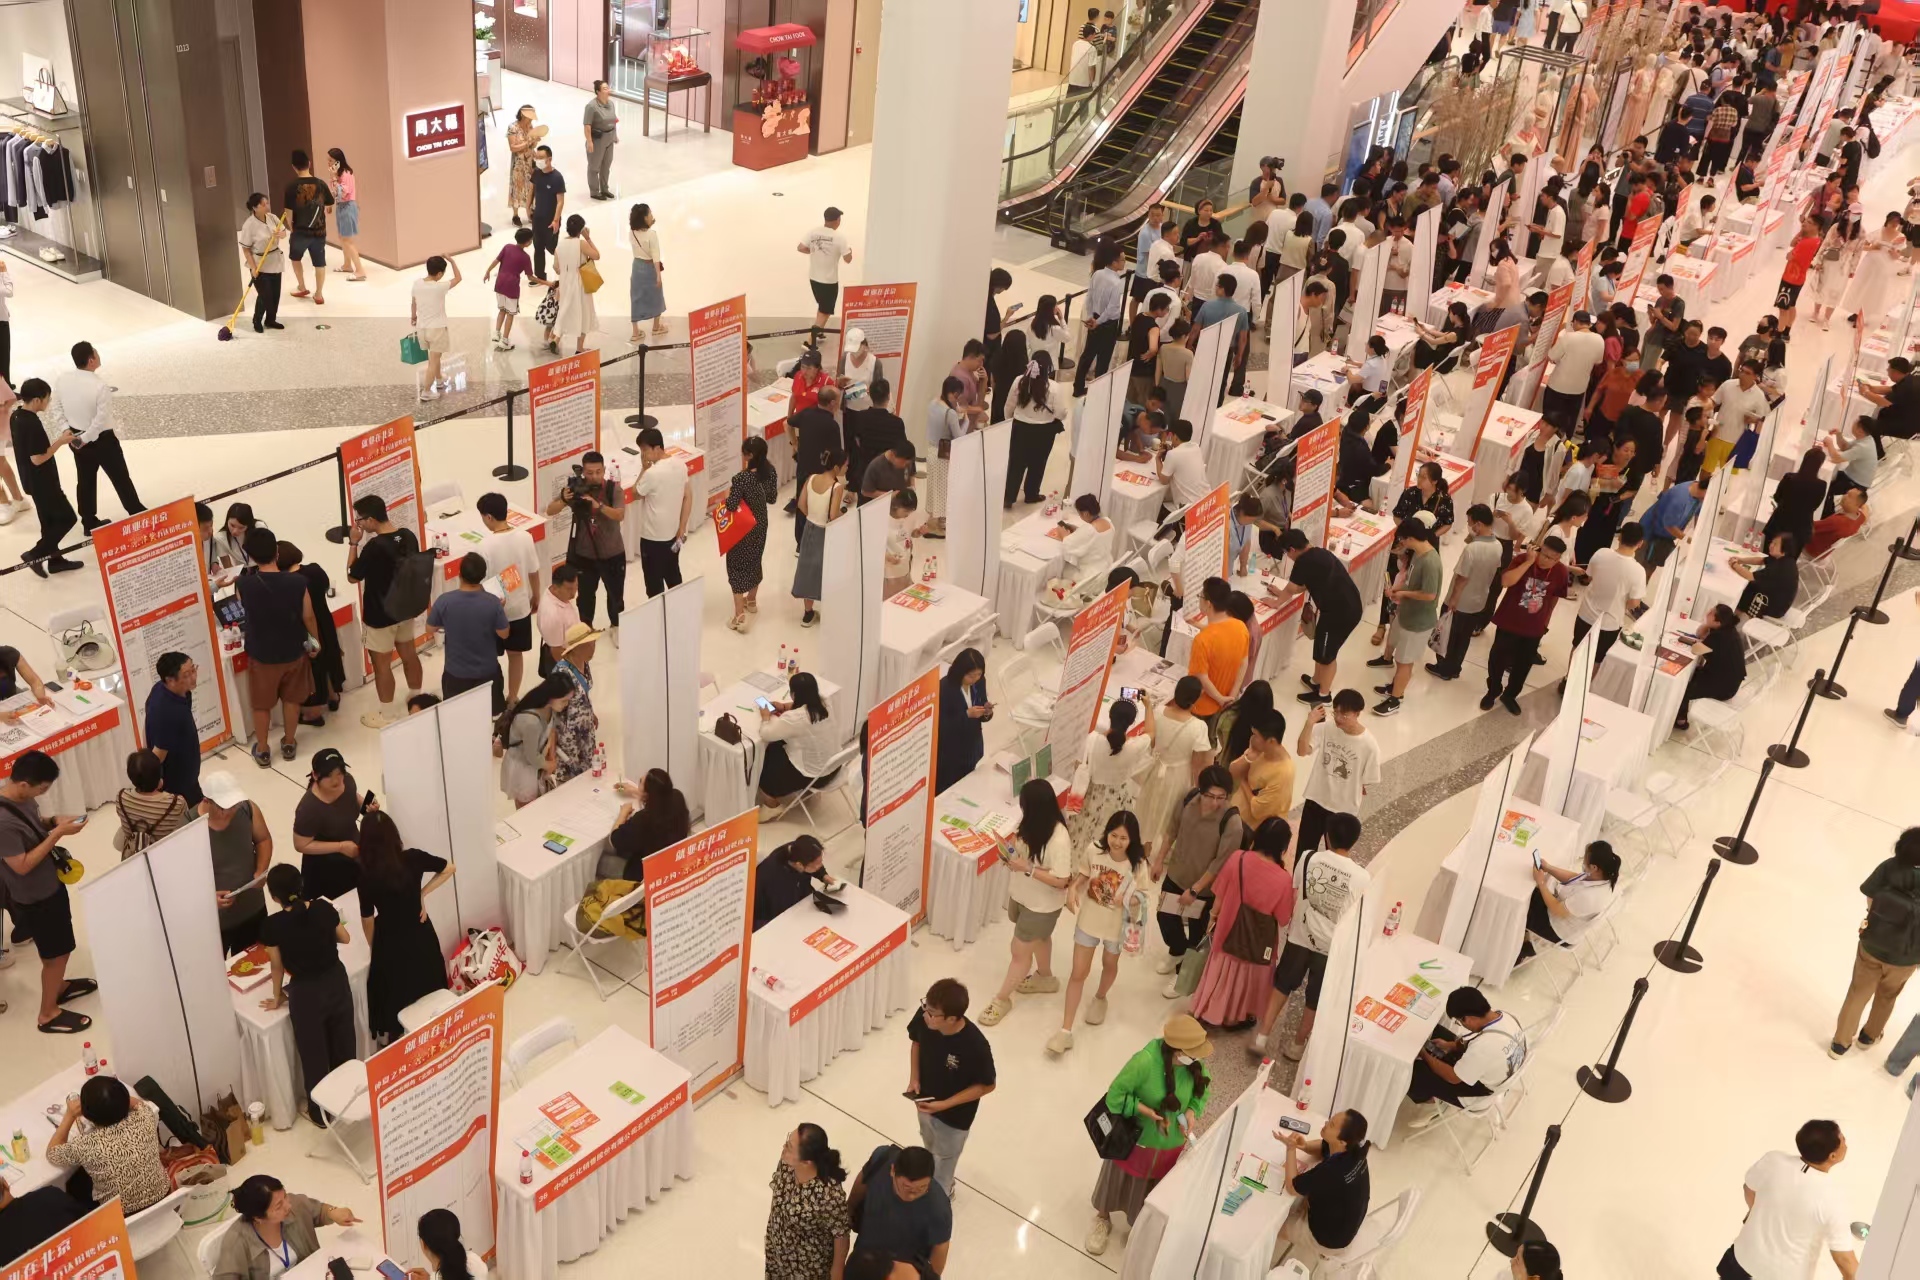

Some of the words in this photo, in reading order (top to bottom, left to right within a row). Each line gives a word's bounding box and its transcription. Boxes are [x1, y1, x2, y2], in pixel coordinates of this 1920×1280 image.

[769, 35, 784, 44] CHOW
[784, 34, 792, 42] TAI
[793, 32, 806, 40] FOOK
[176, 44, 190, 52] 1013
[415, 113, 458, 137] 周大福
[416, 144, 432, 152] CHOW
[432, 141, 442, 149] TAI
[444, 138, 458, 146] FOOK
[791, 1009, 800, 1020] 37
[553, 1092, 683, 1192] 中国石化销售股份有限公司北京石油分公司
